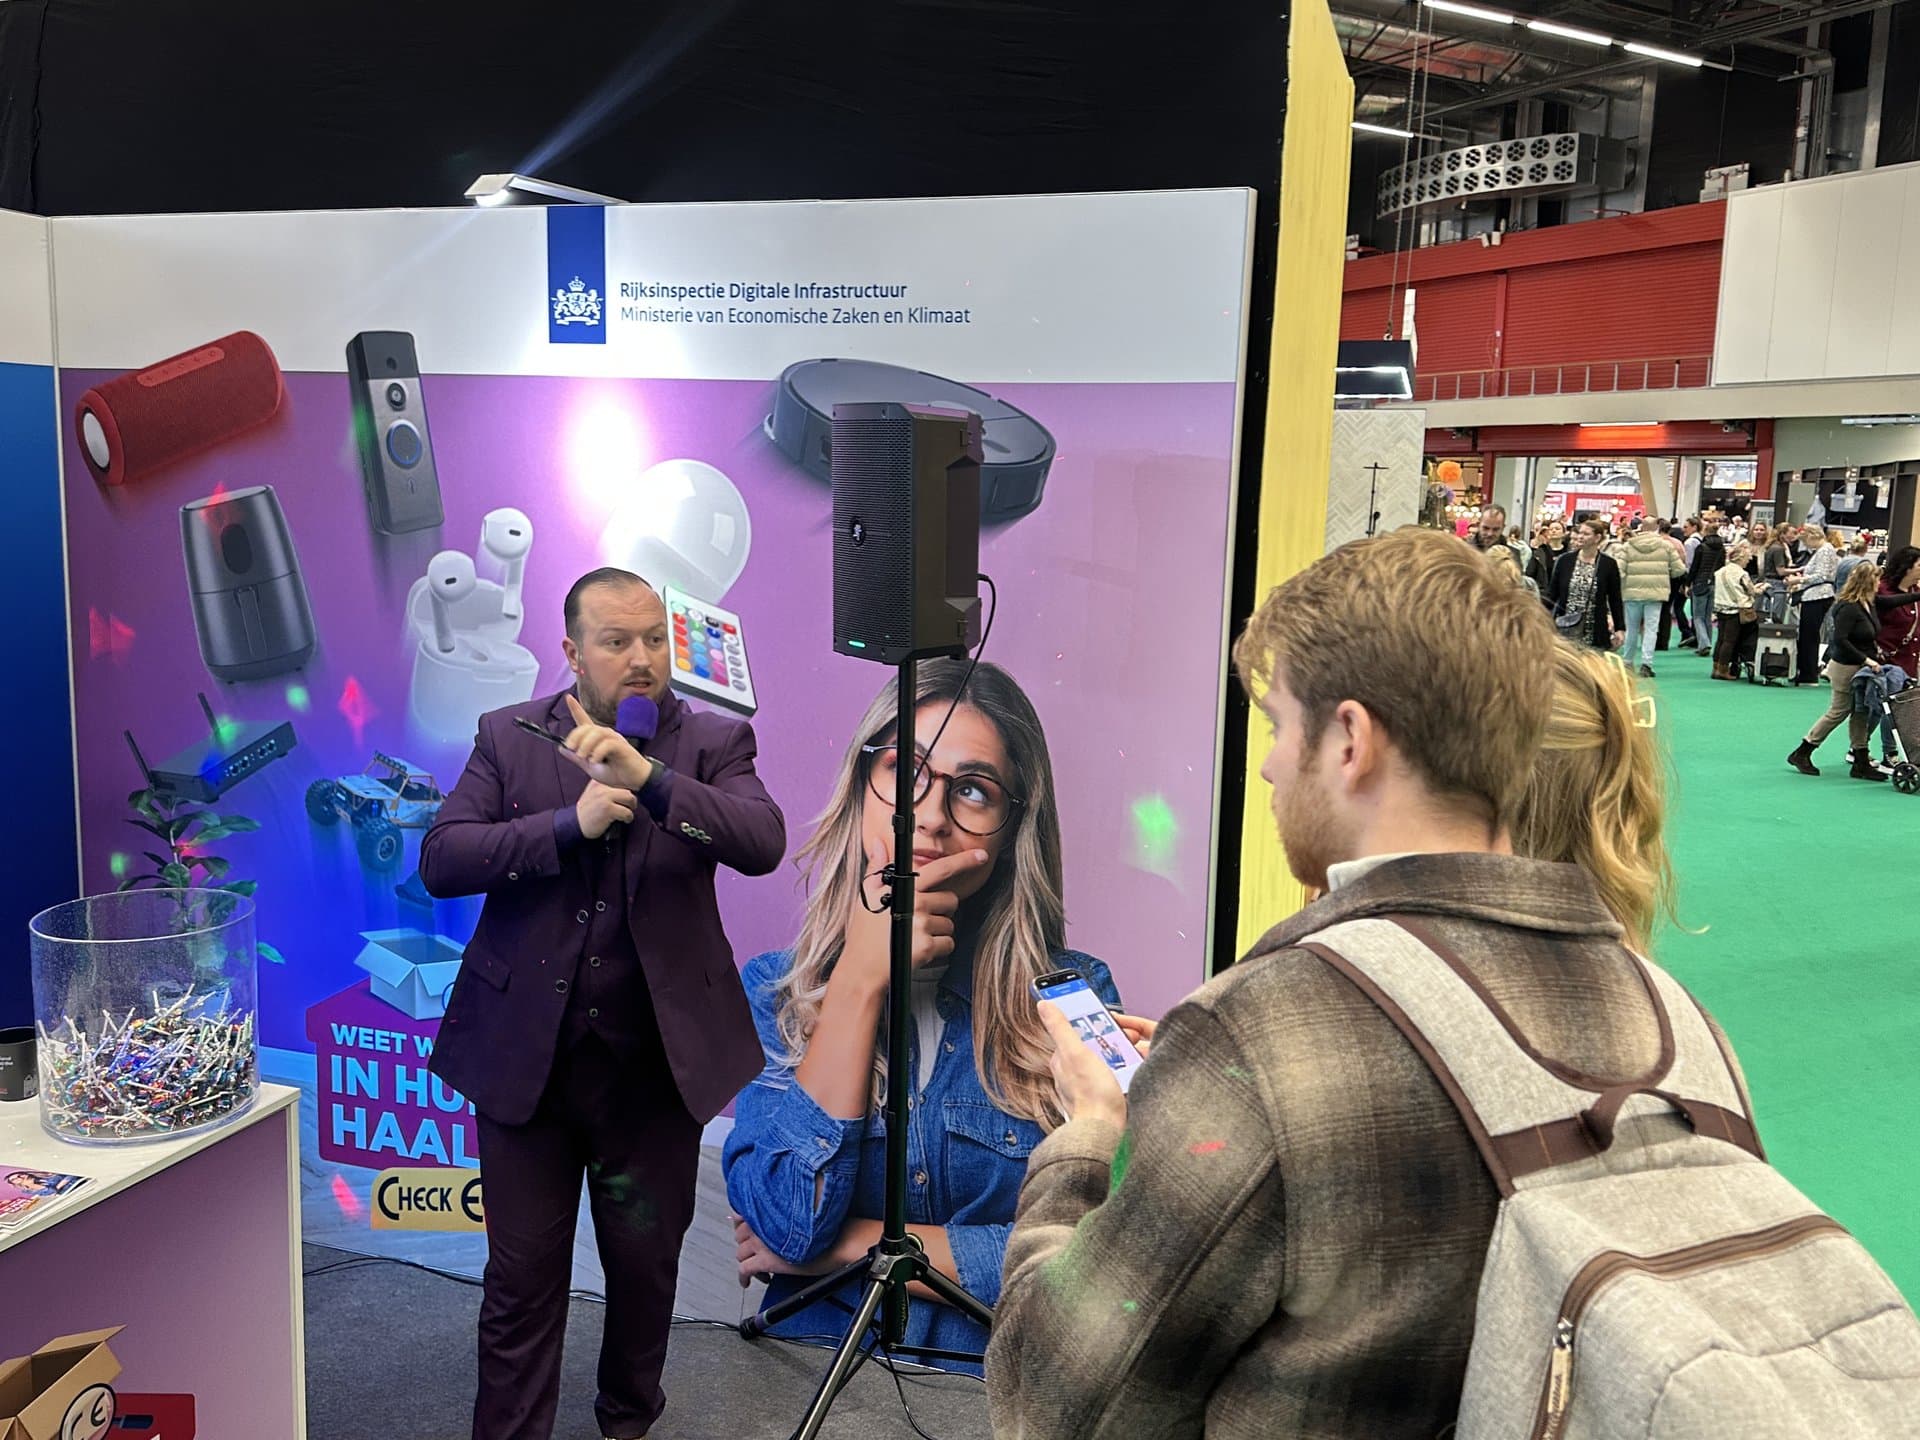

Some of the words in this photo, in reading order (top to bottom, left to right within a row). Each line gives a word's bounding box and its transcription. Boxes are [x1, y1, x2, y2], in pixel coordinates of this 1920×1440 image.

[620, 282, 725, 301] Rijksinspectie
[729, 282, 790, 302] Digitale
[794, 283, 907, 299] Infrastructuur
[621, 306, 693, 323] Ministerie
[696, 310, 724, 323] van
[728, 307, 828, 324] Economische
[832, 308, 880, 323] Zaken
[884, 311, 903, 323] en
[908, 307, 971, 323] Klimaat
[331, 1022, 407, 1054] WEET
[331, 1054, 380, 1100] IN
[395, 1064, 476, 1116] HU
[332, 1103, 481, 1169] HAAL
[378, 1176, 453, 1221] CHECK
